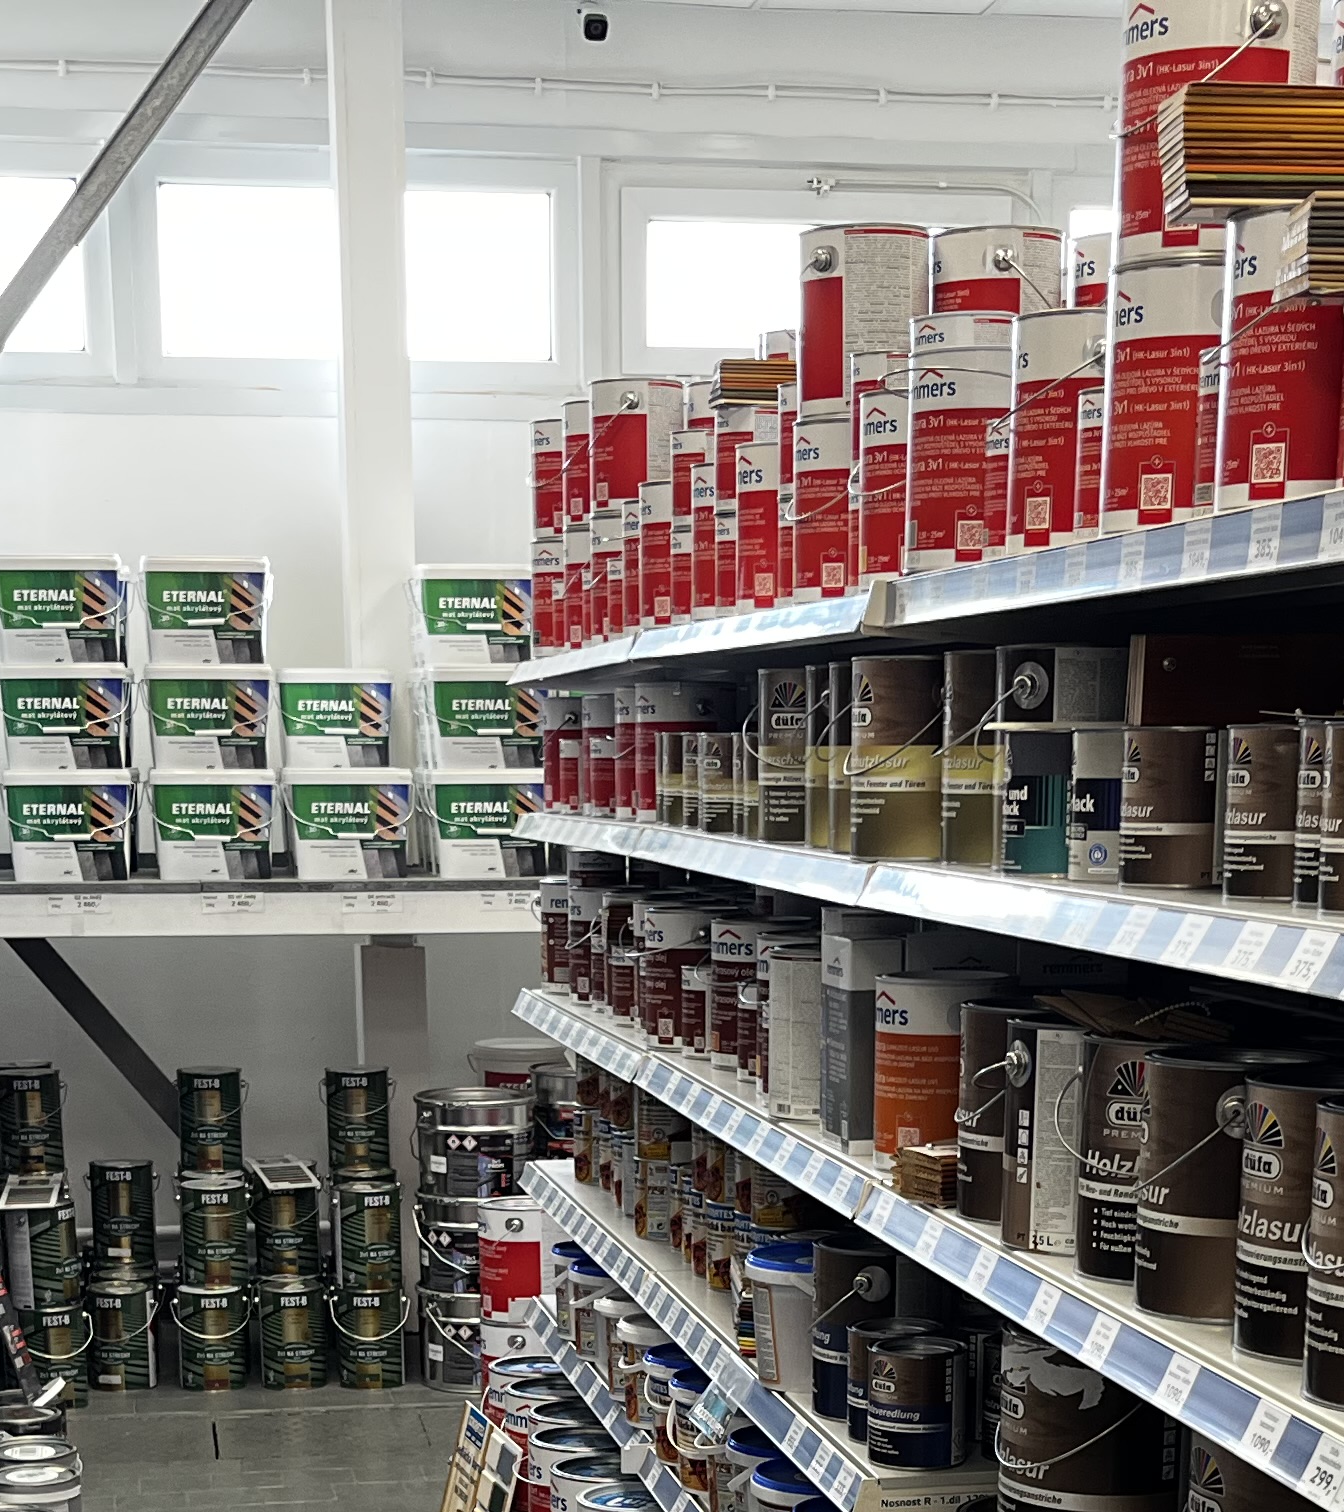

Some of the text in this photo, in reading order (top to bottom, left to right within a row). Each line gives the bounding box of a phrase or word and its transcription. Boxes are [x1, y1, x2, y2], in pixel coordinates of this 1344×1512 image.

[13, 589, 76, 602] ETERNAL
[163, 590, 224, 603] ETERNAL
[439, 597, 497, 609] ETERNAL
[17, 697, 80, 710] ETERNAL
[167, 697, 229, 710] ETERNAL
[298, 700, 355, 712] ETERNAL
[452, 699, 512, 711] ETERNAL
[23, 803, 84, 815] ETERNAL
[1310, 1465, 1340, 1499] 299,-
[881, 1496, 919, 1509] Nosnost
